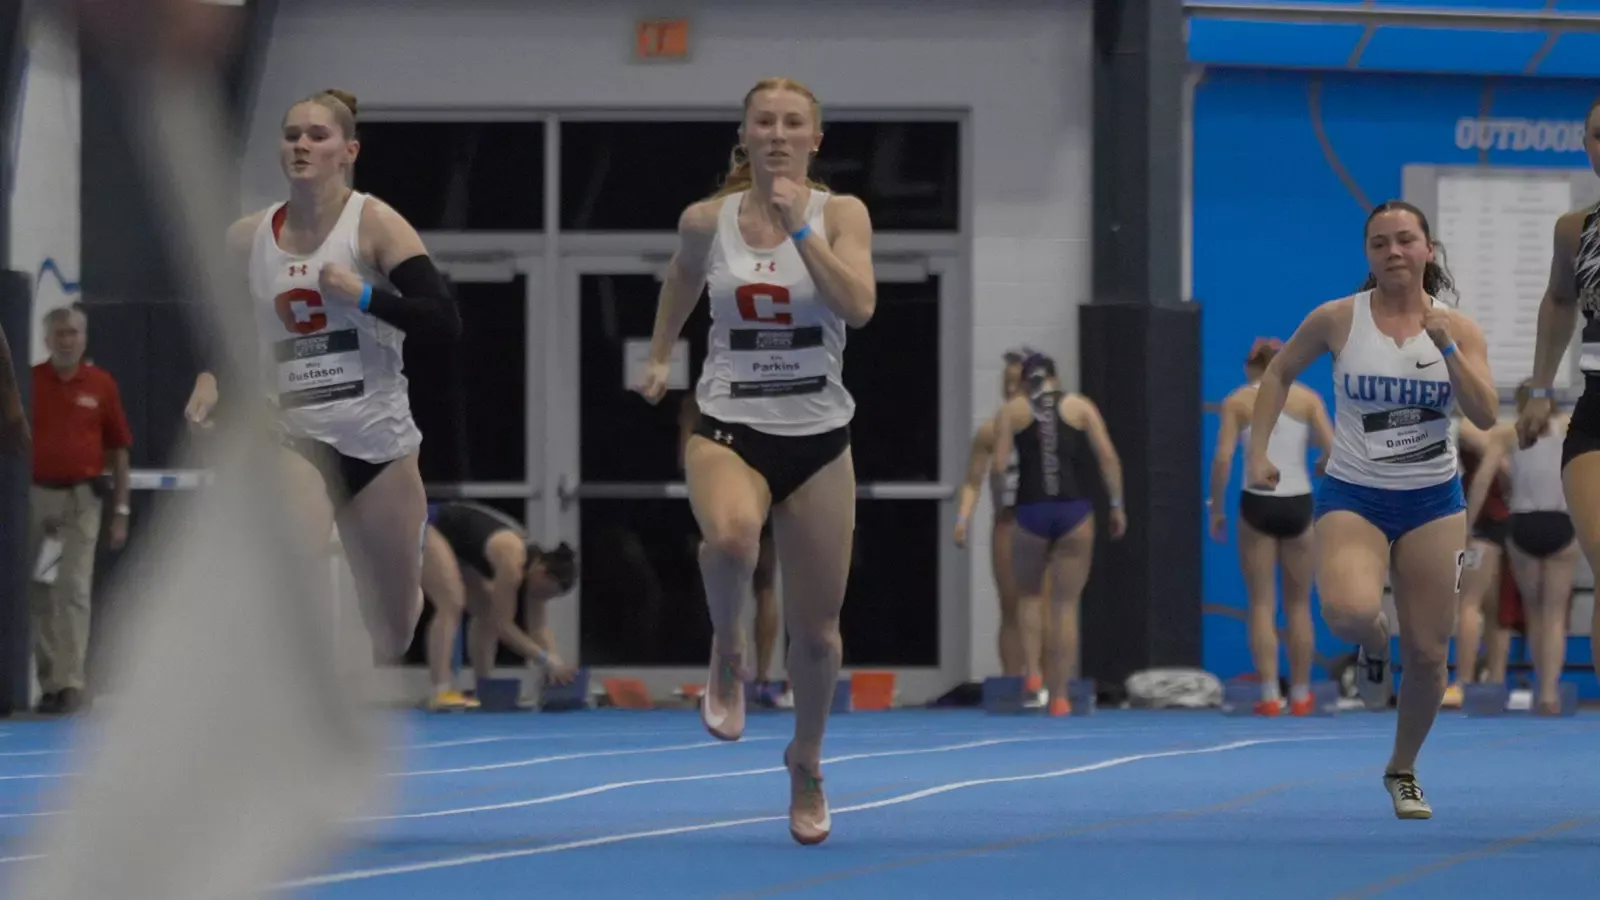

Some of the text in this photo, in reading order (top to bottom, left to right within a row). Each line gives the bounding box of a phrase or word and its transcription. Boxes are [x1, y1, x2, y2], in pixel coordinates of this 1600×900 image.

[274, 288, 327, 334] C
[735, 283, 793, 325] C
[288, 366, 344, 382] Gustason
[752, 362, 801, 372] Parkins
[1344, 373, 1451, 407] LUTHER
[1385, 432, 1429, 449] Damiani
